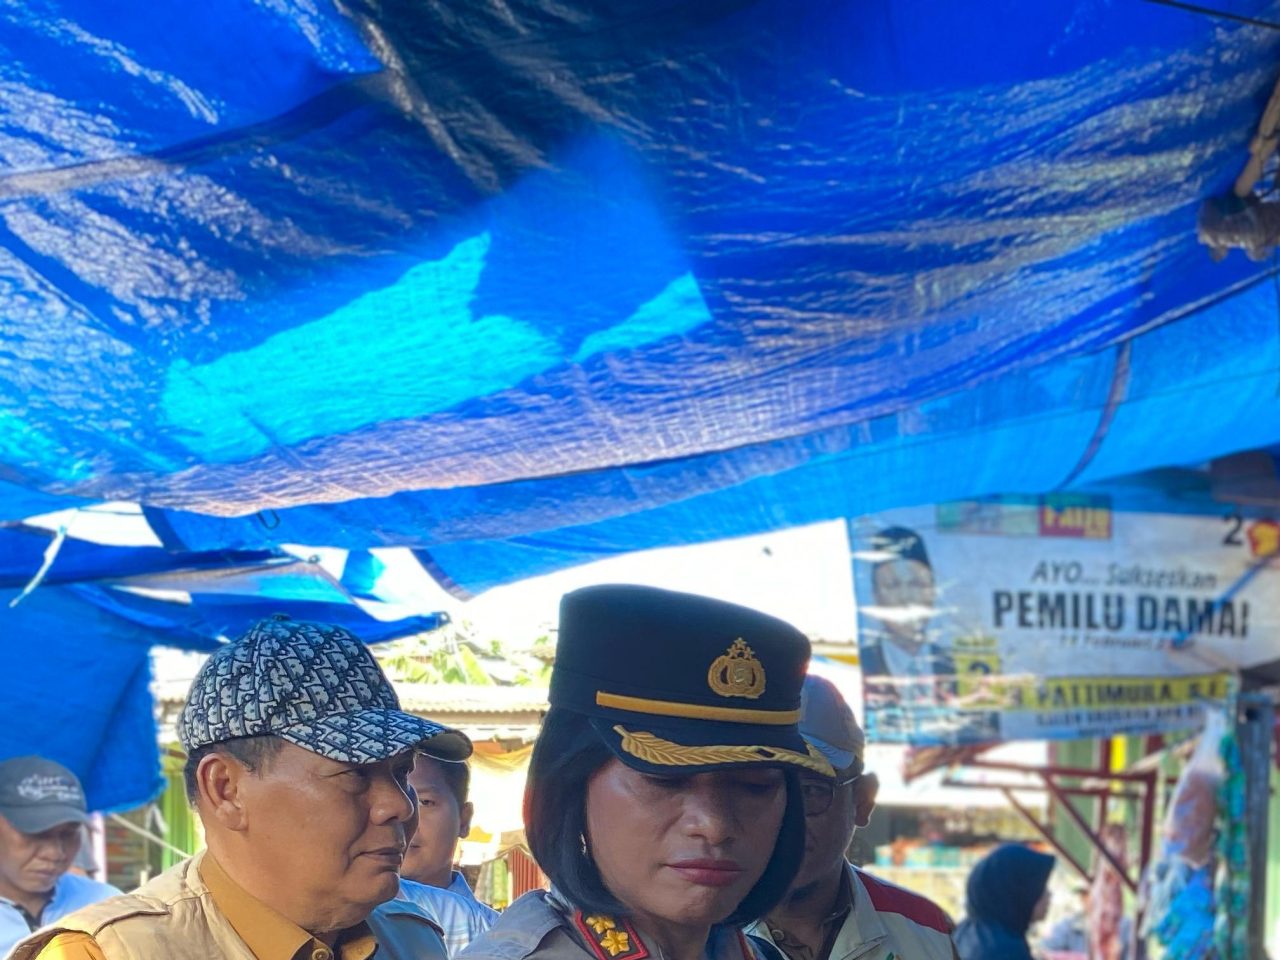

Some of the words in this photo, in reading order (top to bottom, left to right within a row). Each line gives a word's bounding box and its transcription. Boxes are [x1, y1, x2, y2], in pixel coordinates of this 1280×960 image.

[1222, 515, 1243, 545] 2
[1105, 563, 1218, 590] Sukseskan
[992, 590, 1125, 632] PEMILU
